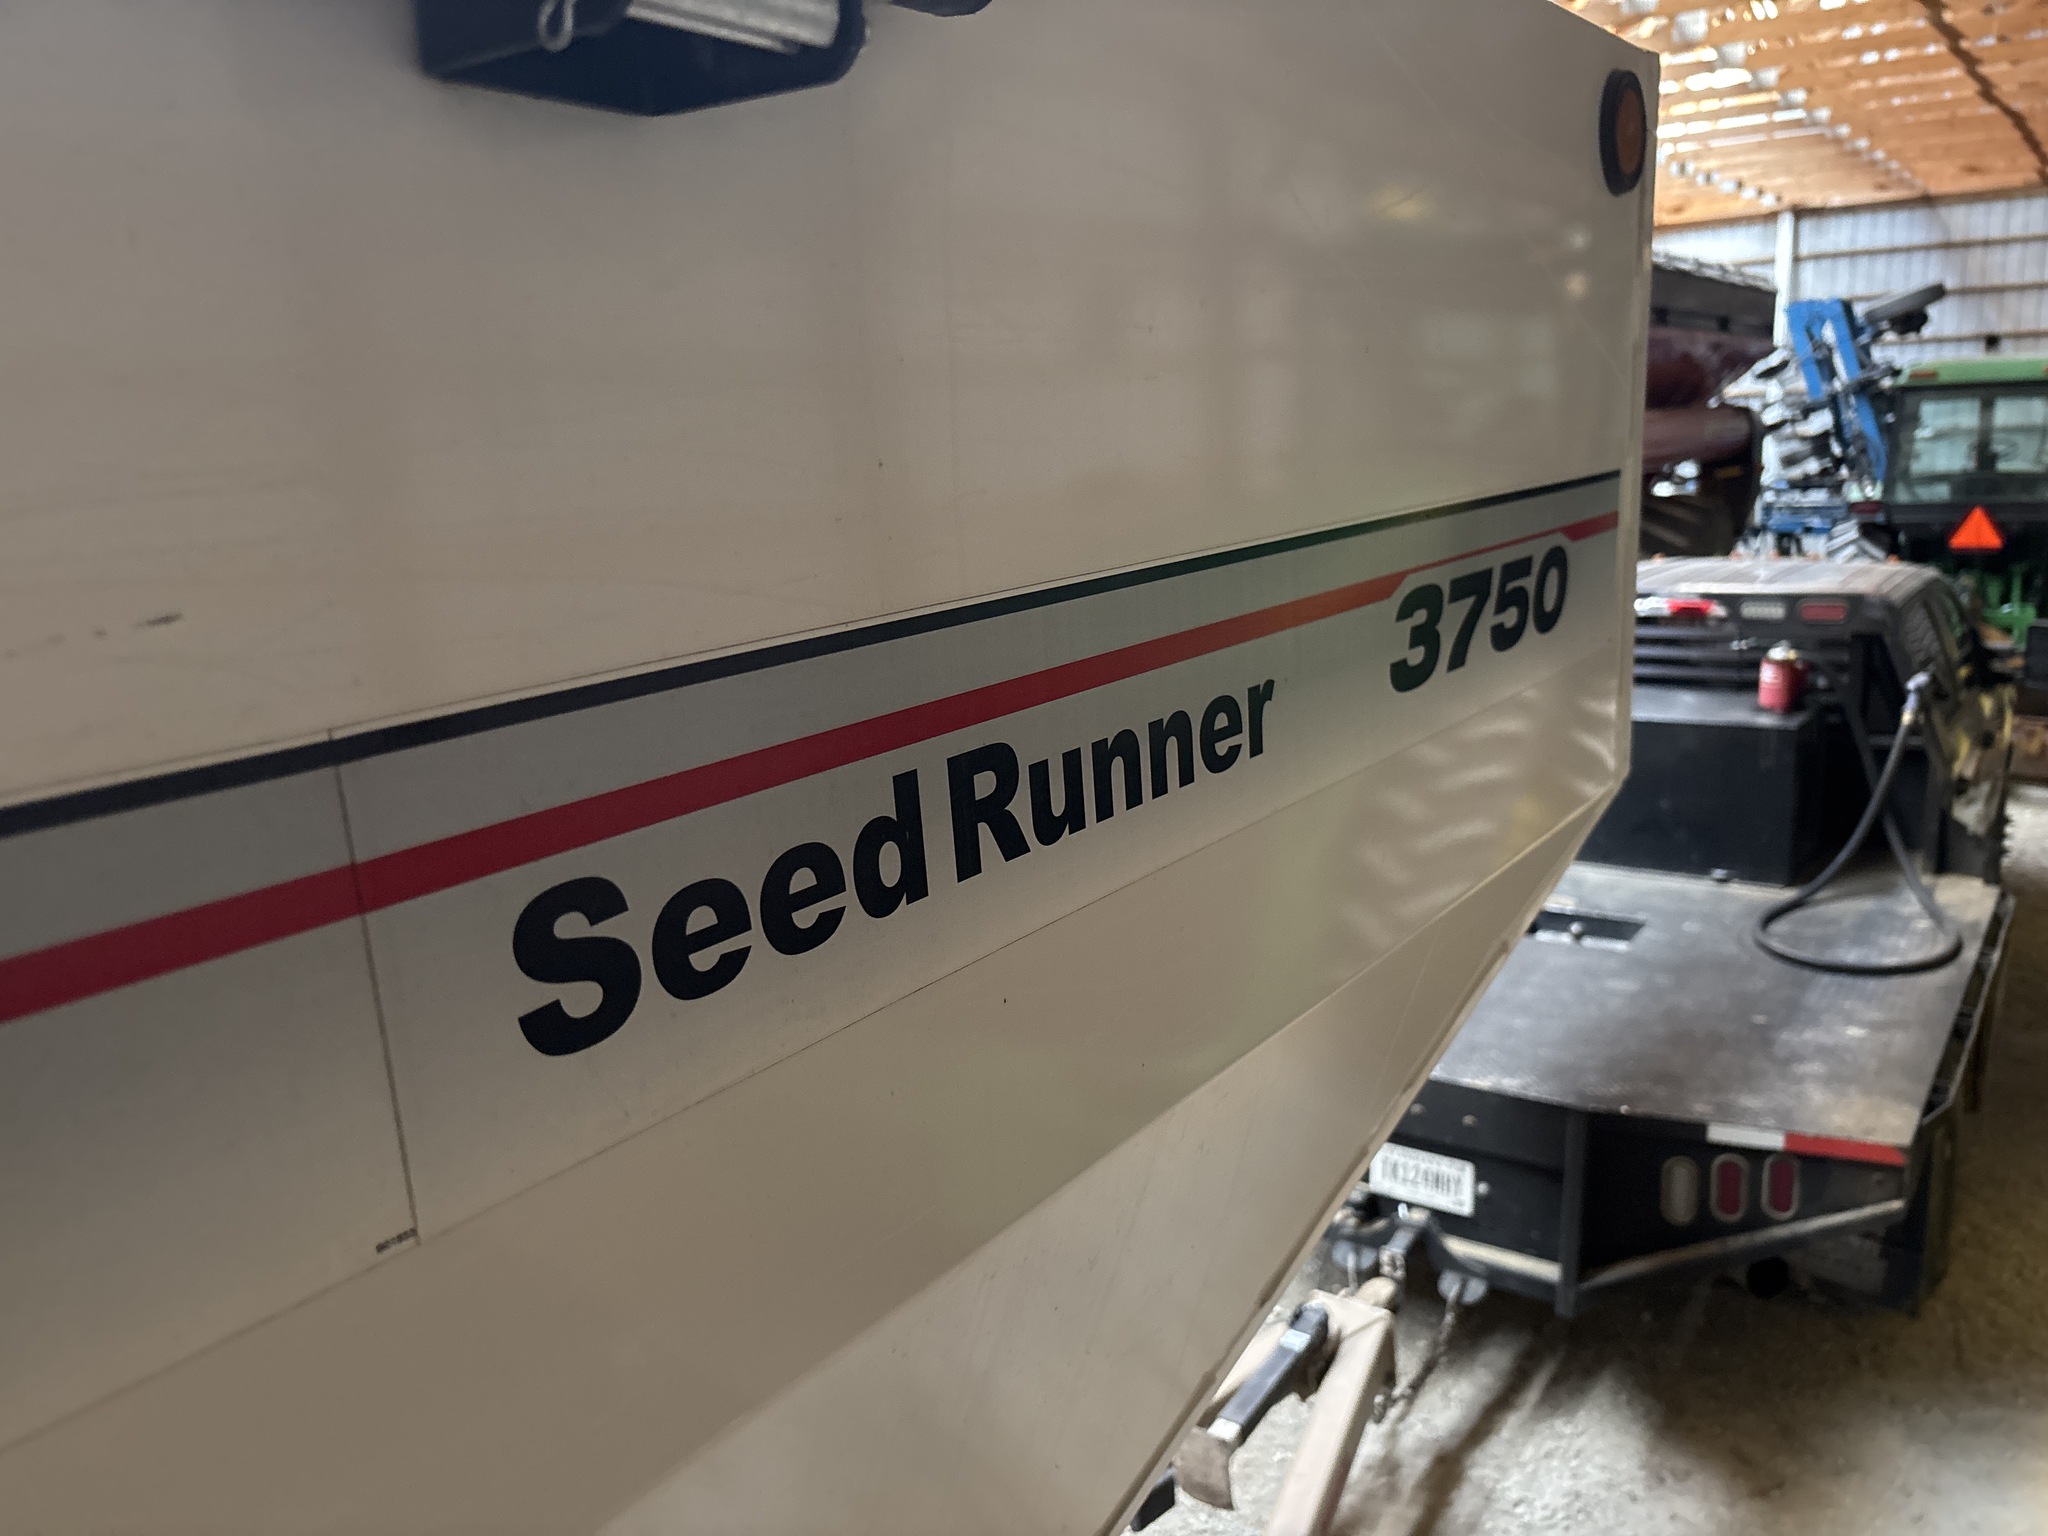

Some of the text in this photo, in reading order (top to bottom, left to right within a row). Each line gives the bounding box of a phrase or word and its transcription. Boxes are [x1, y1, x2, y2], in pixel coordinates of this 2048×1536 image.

[1390, 545, 1569, 692] 3750
[512, 679, 1276, 1057] Seed Runner
